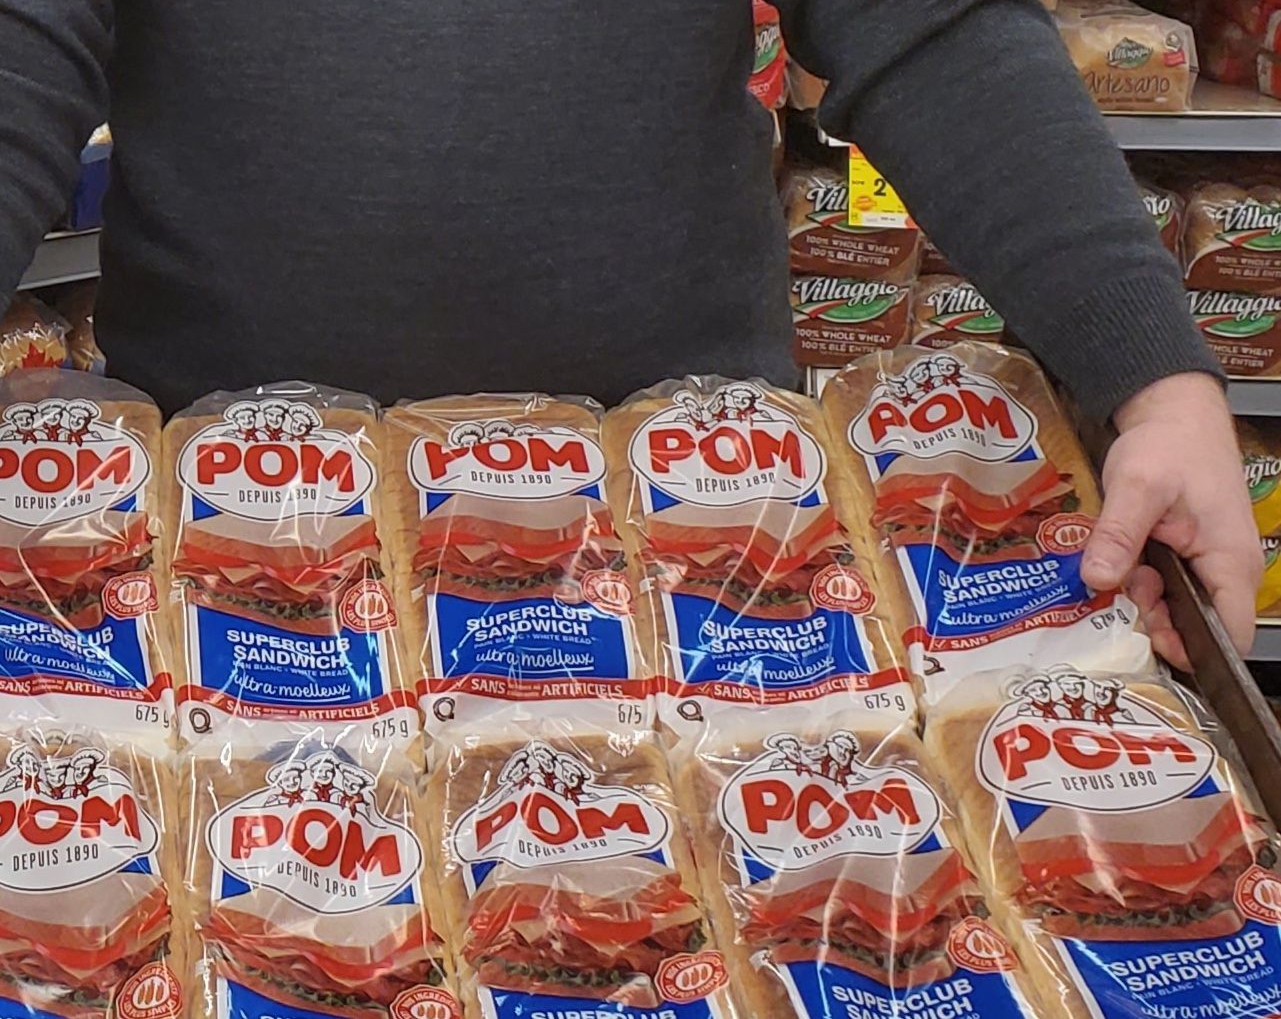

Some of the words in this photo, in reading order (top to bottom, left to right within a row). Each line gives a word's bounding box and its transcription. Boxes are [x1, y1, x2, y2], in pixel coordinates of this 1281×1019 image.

[806, 234, 829, 246] 100%
[831, 238, 864, 251] WHOLE
[867, 243, 900, 256] WHEAT
[836, 249, 855, 262] BLÉ
[856, 254, 891, 267] ENTIER
[791, 277, 900, 307] Villaggio
[796, 328, 820, 338] 100%
[821, 330, 856, 341] WHOLE
[858, 333, 893, 344] WHEAT
[828, 341, 847, 352] BLÉ
[1230, 357, 1265, 368] ENTIER
[1241, 346, 1274, 357] WHEAT
[867, 389, 1019, 445] POM
[913, 428, 958, 451] DEPUIS
[961, 428, 987, 448] 1890
[424, 438, 590, 480] POM
[648, 426, 807, 479] POM
[196, 443, 355, 493] POM
[470, 470, 515, 484] DEPUIS
[521, 473, 552, 485] 1890
[696, 476, 740, 492] DEPUIS
[746, 472, 775, 488] 1890
[14, 494, 57, 510] DEPUIS
[239, 489, 282, 503] DEPUIS
[939, 560, 1060, 588] SUPERCLUB
[942, 571, 1058, 603] SANDWICH
[466, 604, 593, 632] SUPERCLUB
[703, 615, 827, 639] SUPERCLUB
[226, 629, 350, 653] SUPERCLUB
[474, 618, 588, 642] SANDWICH
[533, 633, 560, 642] WHITE
[562, 634, 592, 645] BREAD
[710, 632, 826, 655] SANDWICH
[950, 634, 989, 650] SANS
[233, 644, 346, 670] SANDWICH
[253, 663, 283, 673] BLANC
[320, 669, 348, 678] BREAD
[64, 681, 145, 700] ARTIFICIELS
[470, 678, 506, 694] SANS
[541, 682, 624, 699] ARTIFICIELS
[713, 684, 751, 699] SANS
[787, 676, 869, 700] ARTIFICIELS
[135, 704, 160, 723] 675
[226, 701, 261, 717] SANS
[298, 703, 380, 721] ARTIFICIELS
[618, 704, 642, 724] 675
[864, 693, 892, 710] 675
[896, 694, 906, 712] g
[372, 718, 396, 739] 675
[400, 720, 408, 738] g
[993, 723, 1197, 782] POM
[1061, 773, 1115, 791] DEPUIS
[1121, 770, 1158, 789] 1890
[740, 778, 921, 840] POM
[474, 792, 651, 853] POM
[231, 809, 402, 881] POM
[572, 839, 608, 853] 1890
[793, 833, 842, 860] DEPUIS
[847, 825, 882, 839] 1890
[13, 848, 59, 872] DEPUIS
[66, 843, 99, 862] 1890
[277, 860, 320, 887] DEPUIS
[325, 878, 357, 898] 1890
[1110, 930, 1265, 977] SUPERCLUB
[1127, 950, 1266, 992] SANDWICH
[832, 978, 973, 1015] SUPERCLUB
[1158, 982, 1194, 996] BLANC
